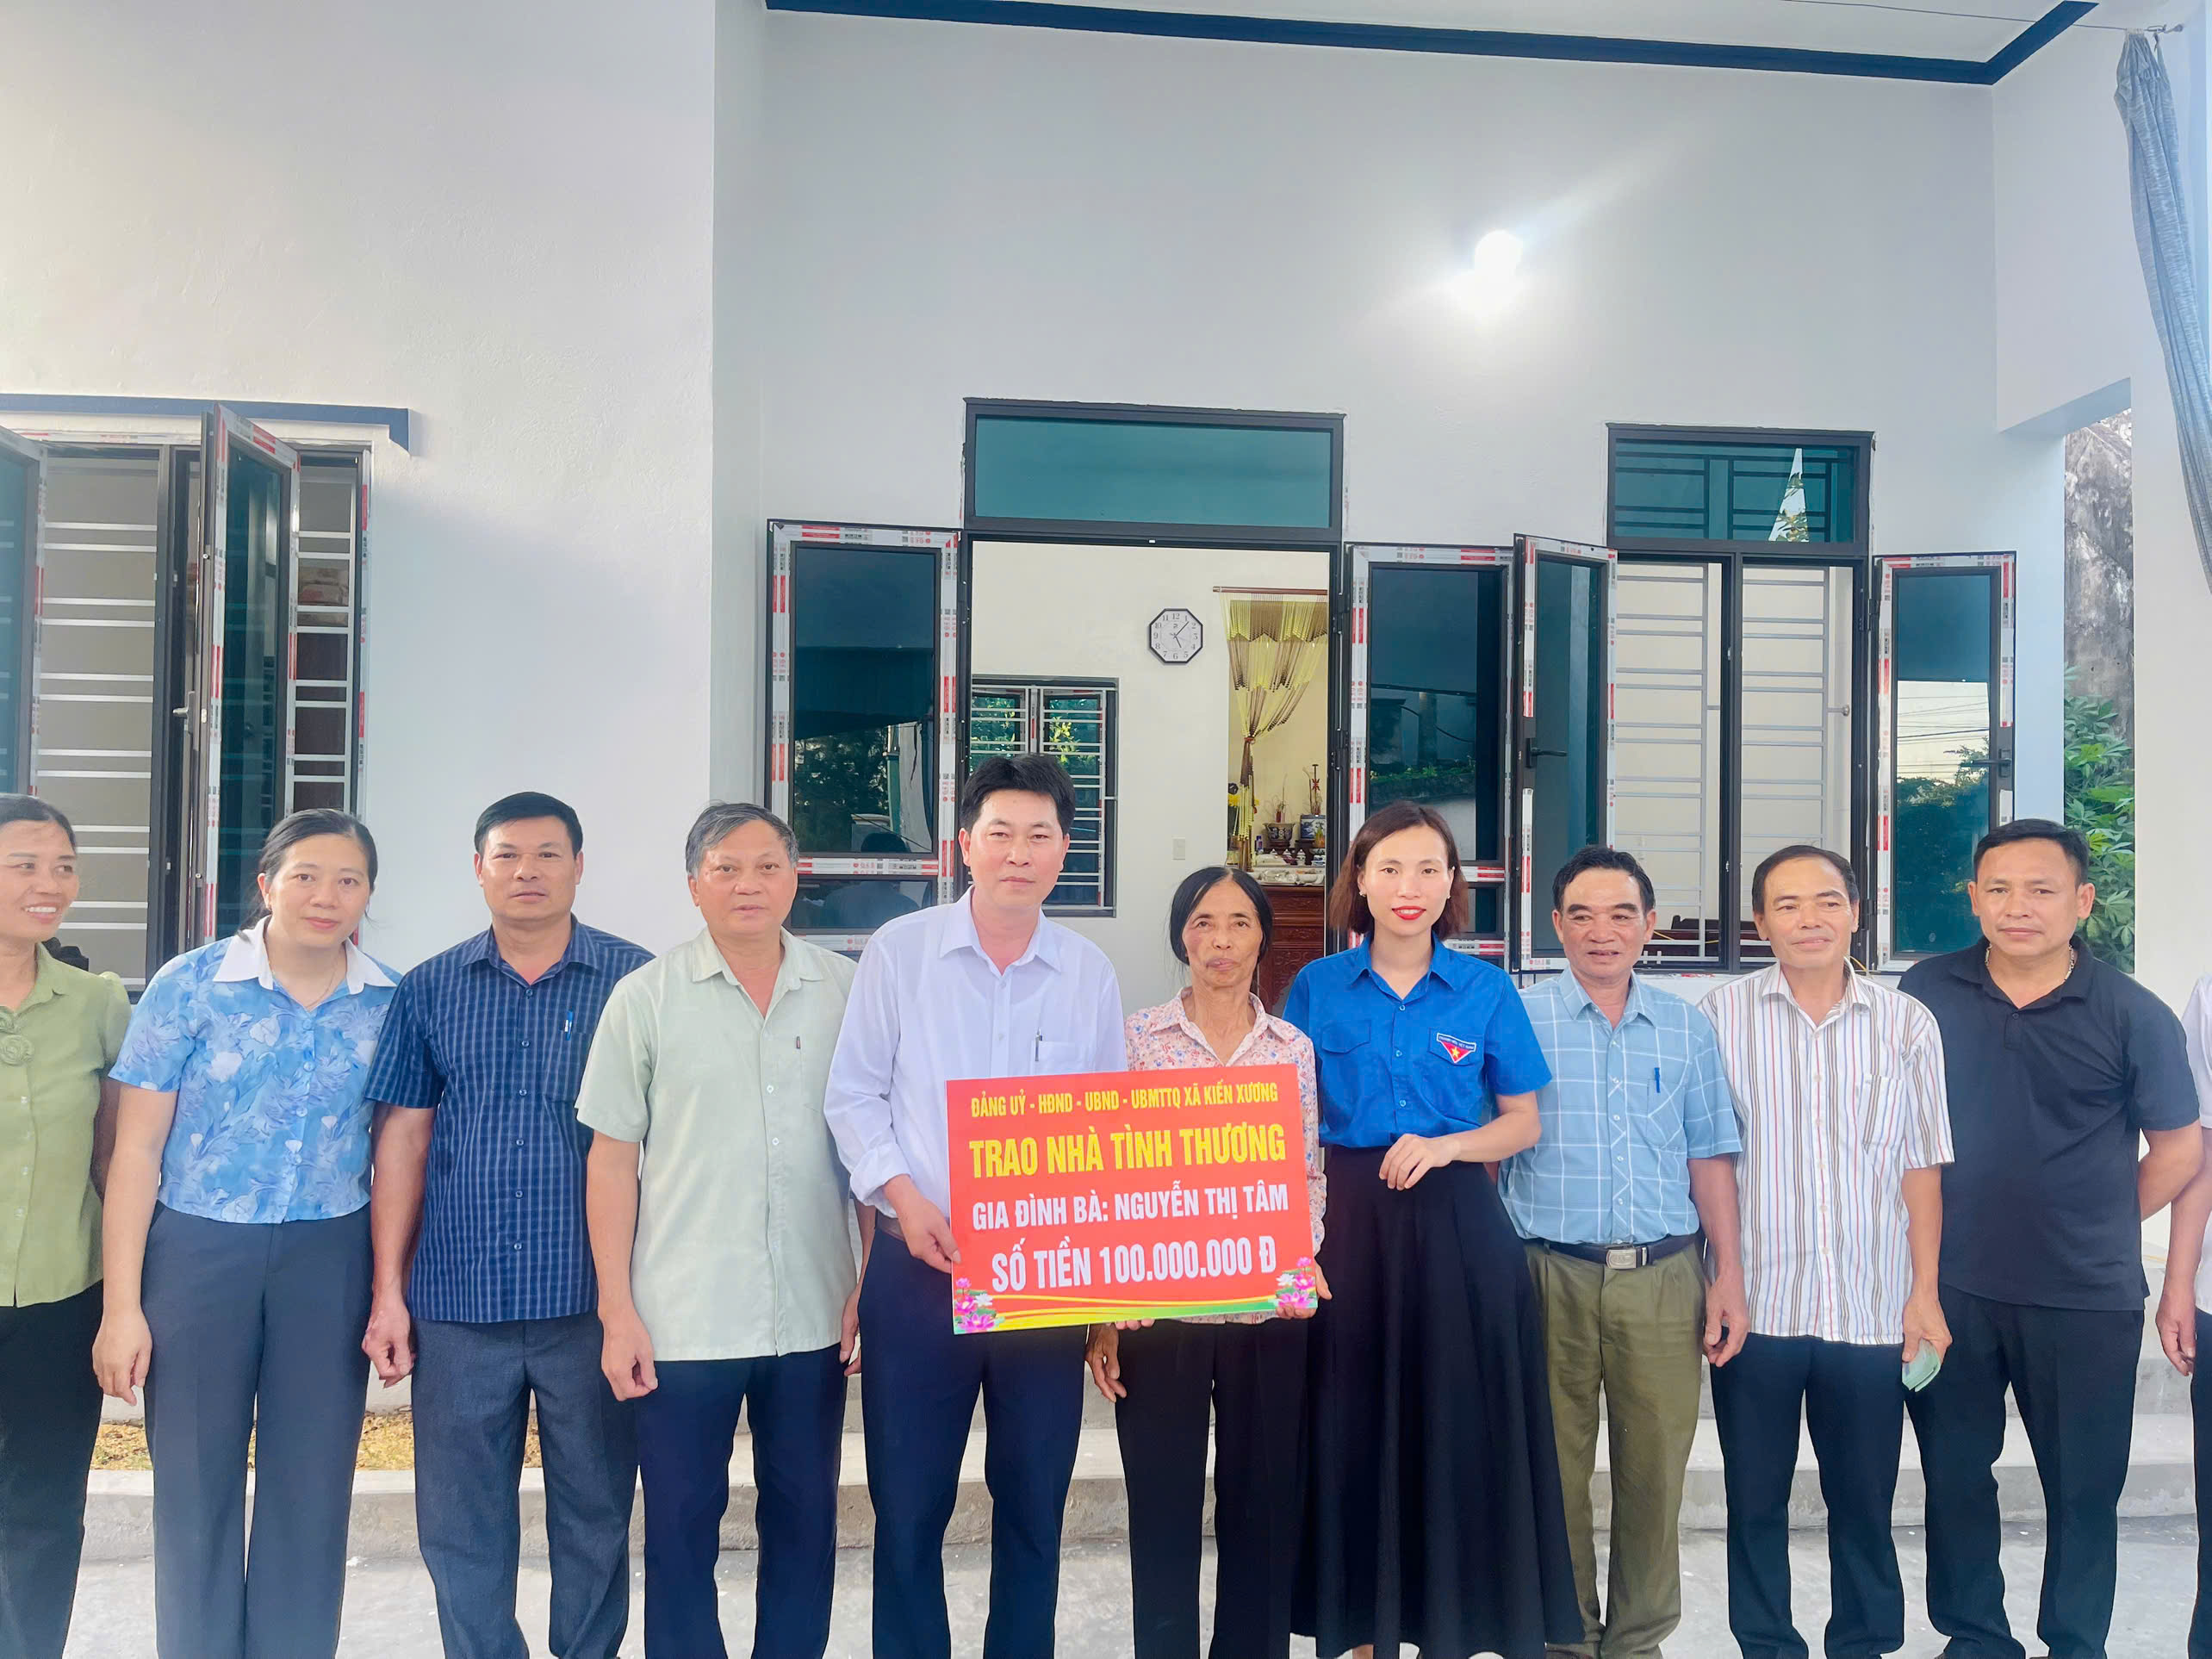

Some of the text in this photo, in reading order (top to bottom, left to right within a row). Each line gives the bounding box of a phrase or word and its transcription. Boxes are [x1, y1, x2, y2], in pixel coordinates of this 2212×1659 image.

[971, 1090, 1006, 1117] ĐẢNG
[1010, 1089, 1027, 1115] UỶ
[1039, 1093, 1072, 1114] HĐND
[1085, 1090, 1119, 1110] UBND
[1132, 1086, 1181, 1109] UBMTTQ
[1184, 1082, 1201, 1106] XÃ
[1236, 1083, 1278, 1103] XƯƠNG
[970, 1122, 1286, 1177] TRAO NHÀ TÌNH THƯƠNG
[972, 1180, 1289, 1230] GIA ĐÌNH BÀ: NGUYỄN THỊ TÂM
[991, 1235, 1277, 1292] SỐ TIỀN 100.000.000 Đ
